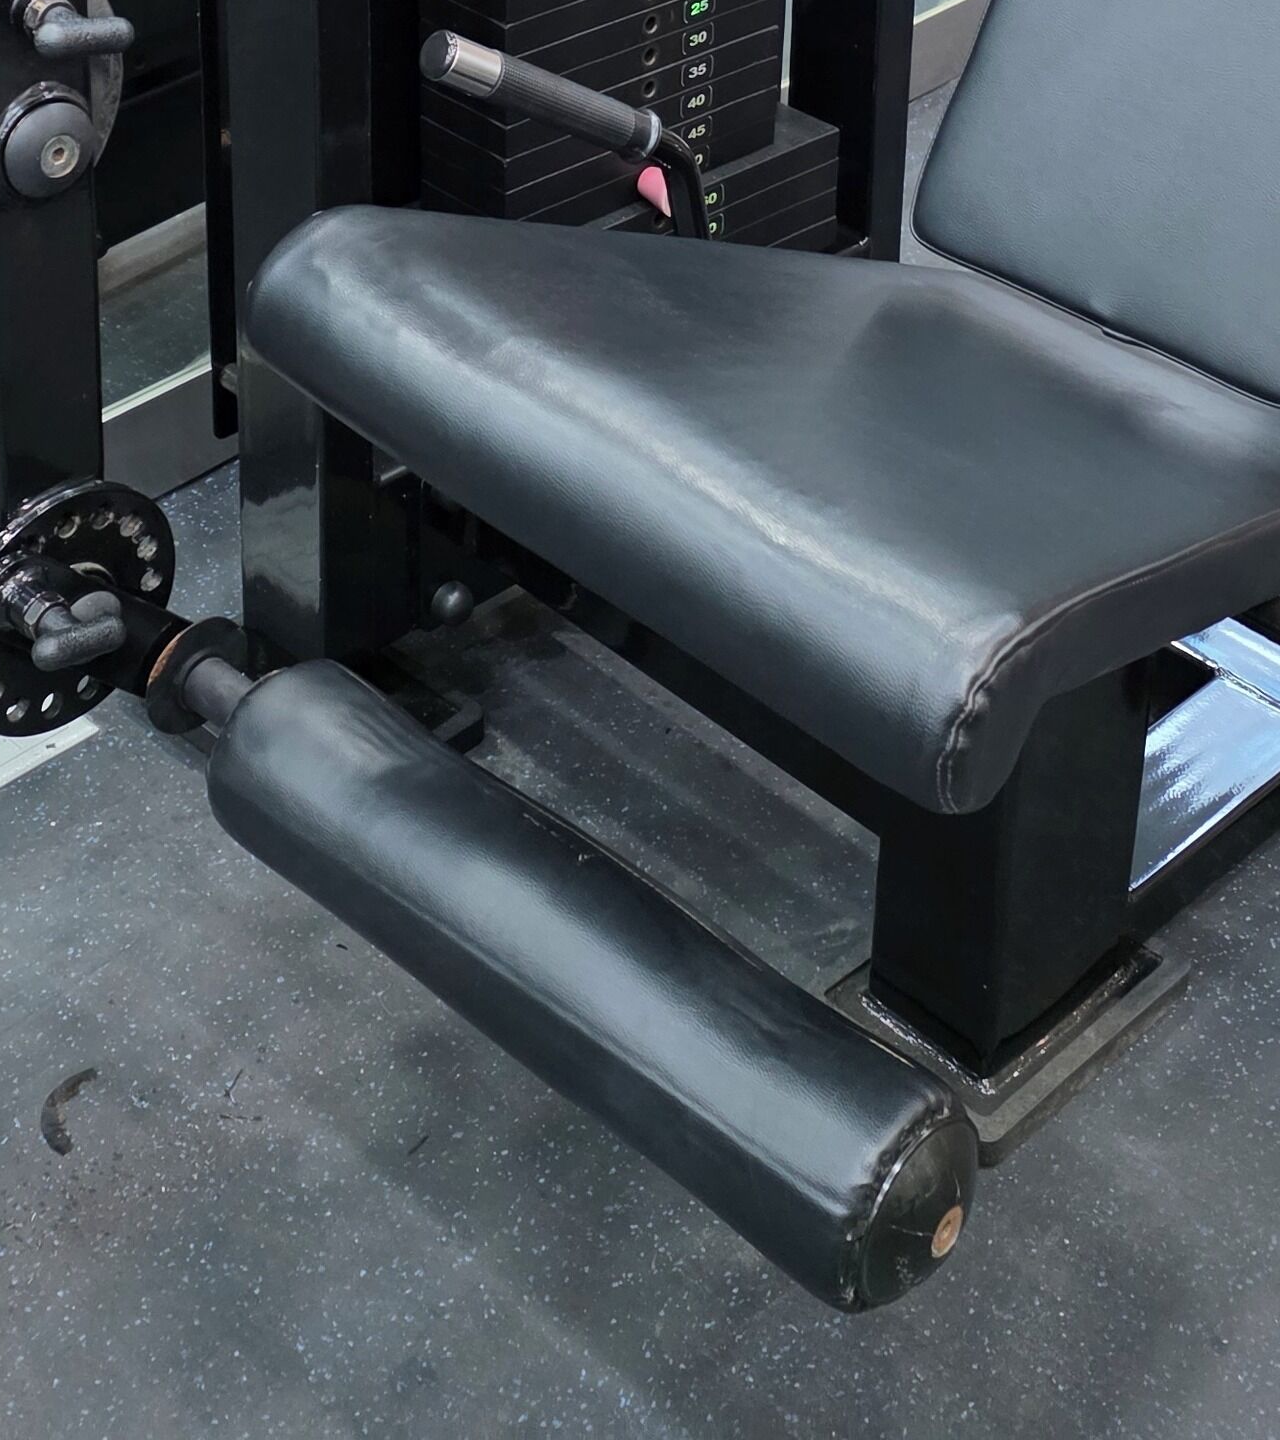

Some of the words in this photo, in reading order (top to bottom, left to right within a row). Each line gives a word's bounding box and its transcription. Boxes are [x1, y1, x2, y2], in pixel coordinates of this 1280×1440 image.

[689, 30, 708, 47] 30
[688, 62, 707, 79] 35
[687, 93, 706, 109] 40
[687, 124, 706, 139] 45
